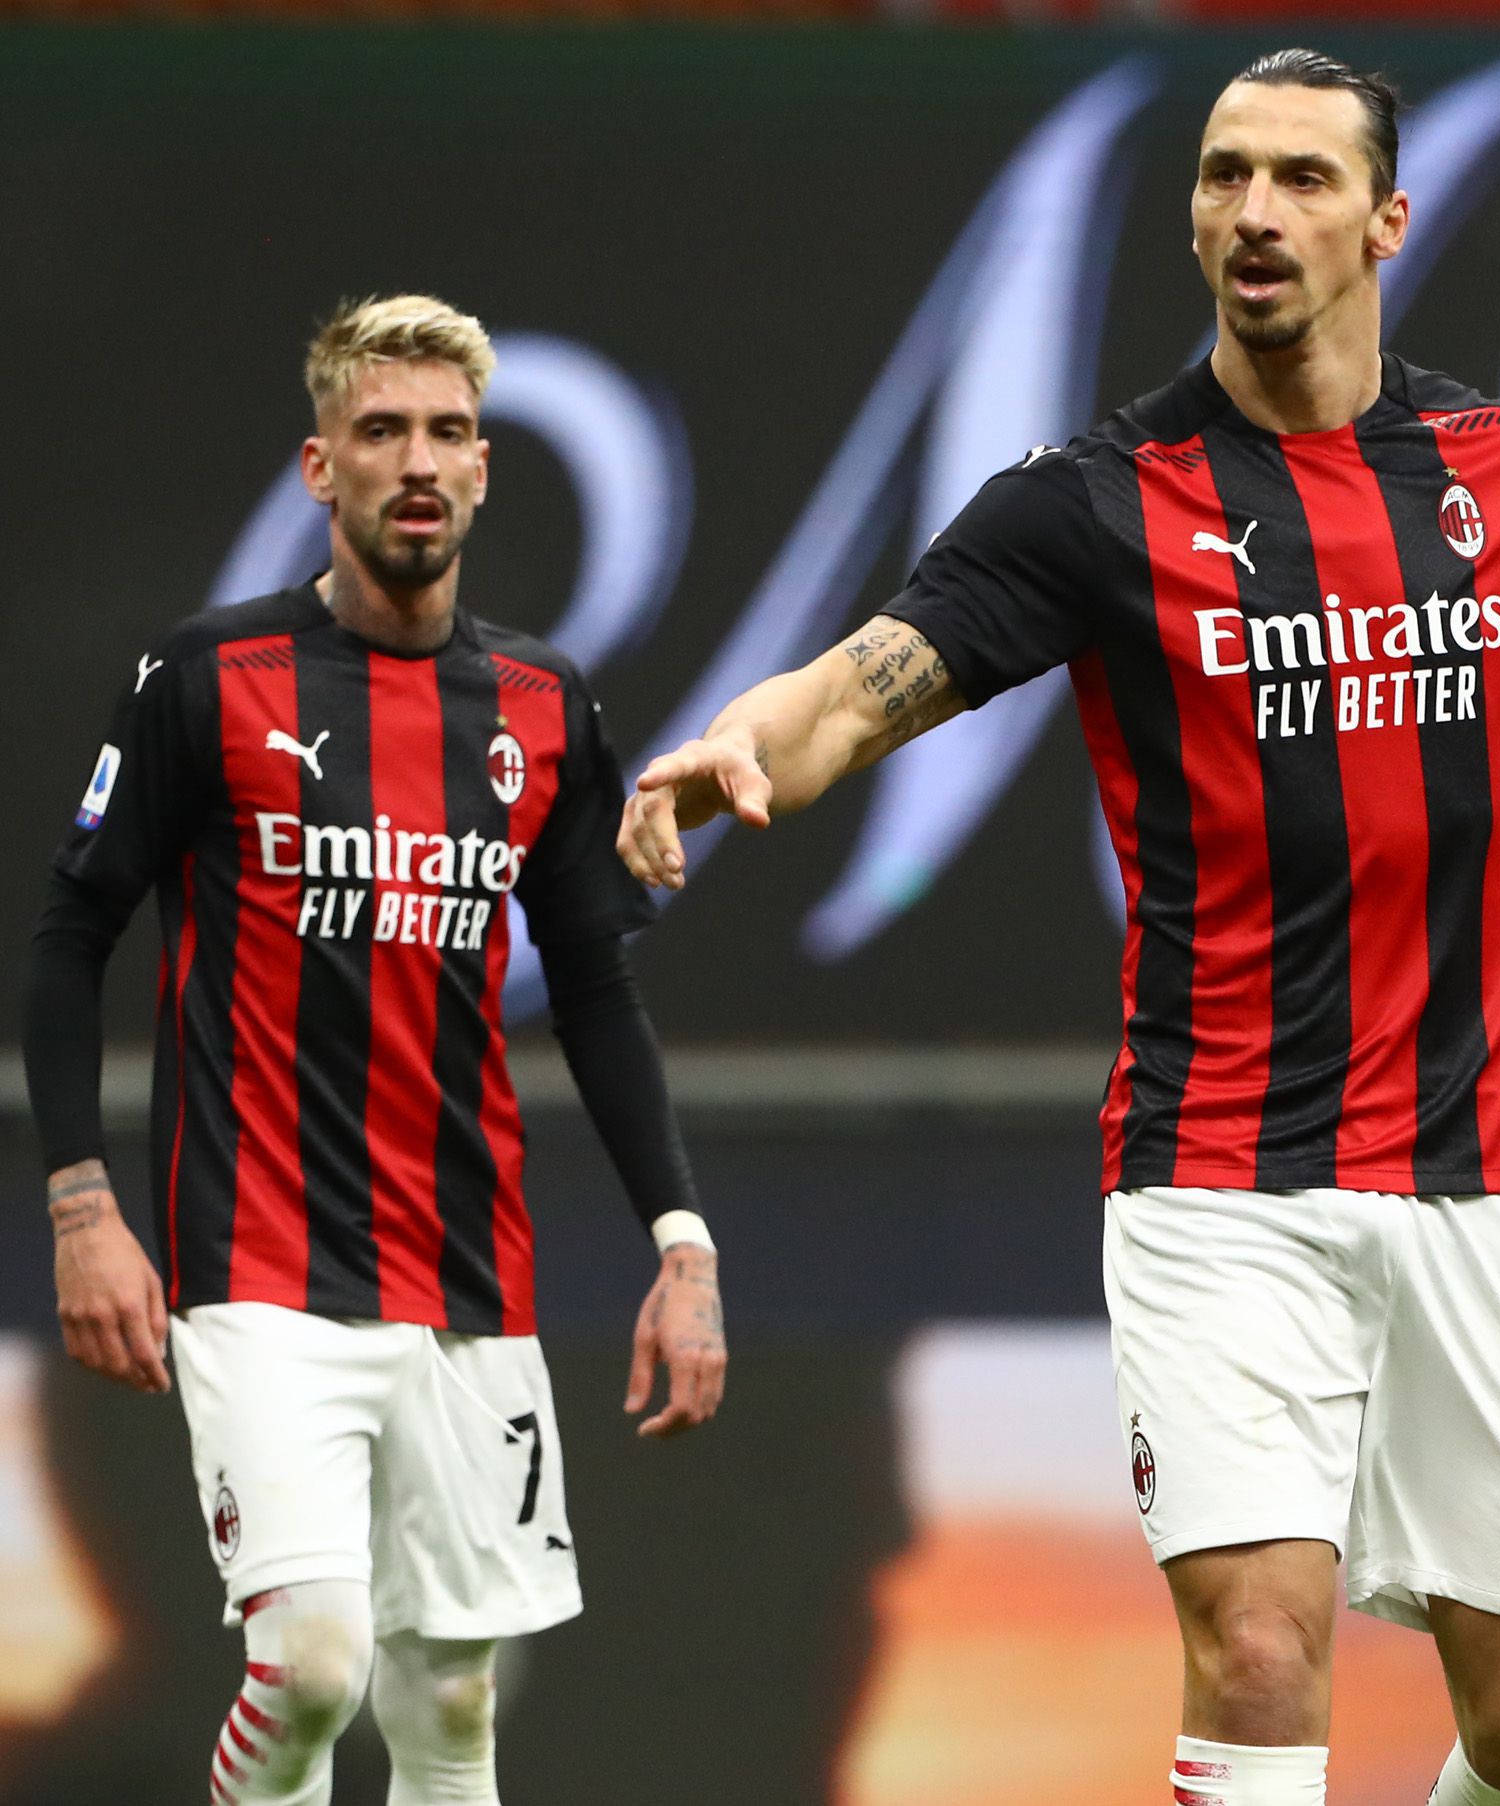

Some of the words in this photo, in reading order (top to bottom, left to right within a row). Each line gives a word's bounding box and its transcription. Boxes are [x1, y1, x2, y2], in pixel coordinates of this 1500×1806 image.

[1446, 487, 1471, 503] ACM
[1257, 678, 1322, 740] FLY
[1337, 664, 1477, 732] BETTER
[254, 811, 528, 893] Emirates
[296, 886, 367, 940] FLY
[373, 890, 492, 951] BETTER
[504, 1410, 543, 1525] 7
